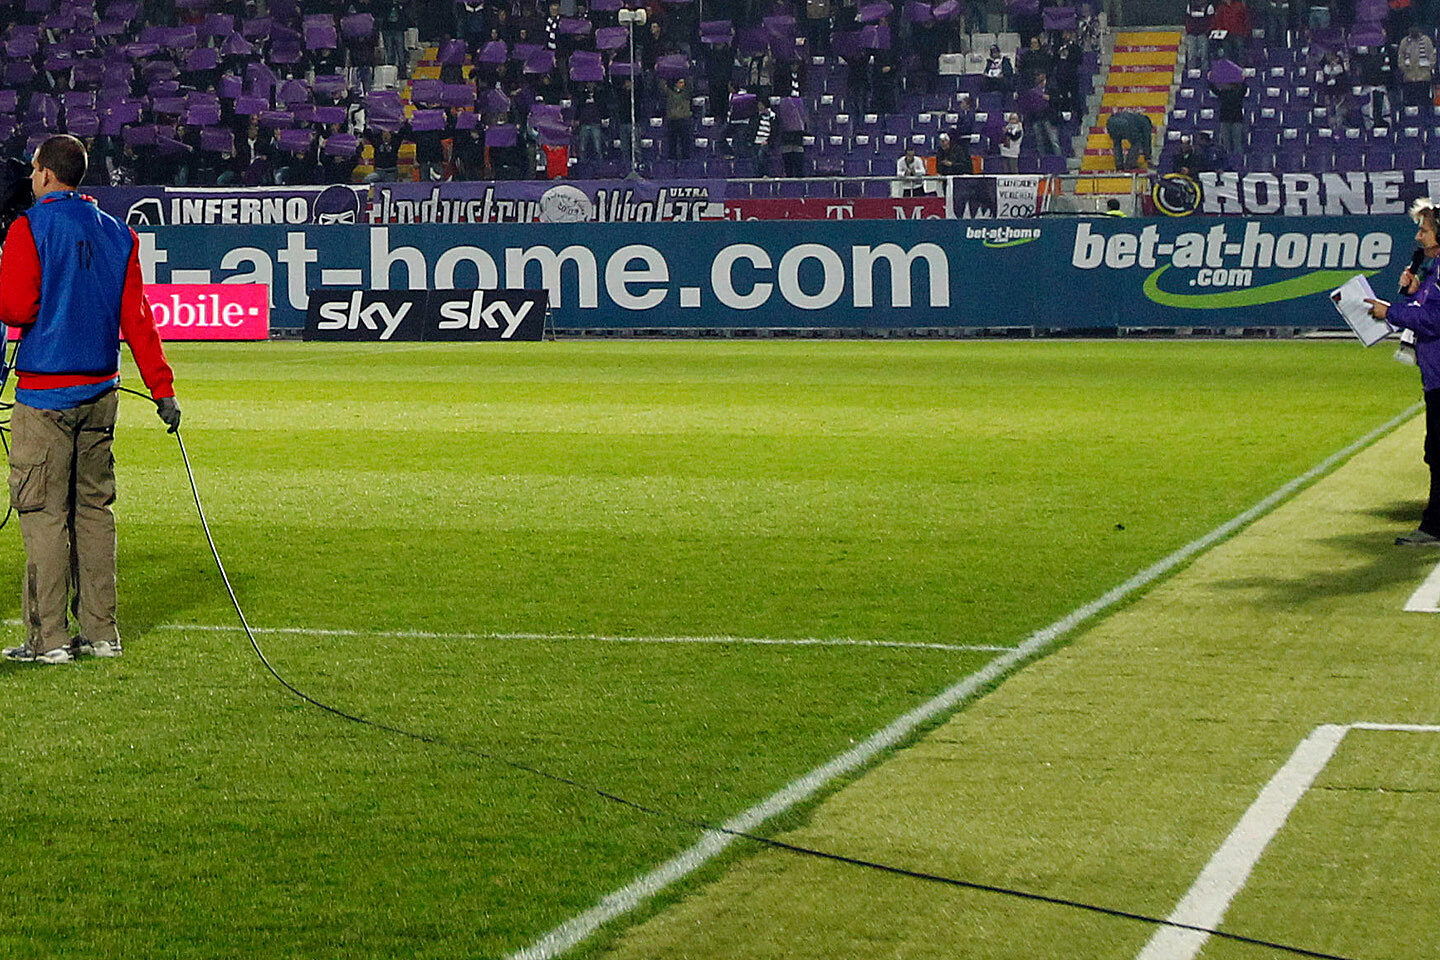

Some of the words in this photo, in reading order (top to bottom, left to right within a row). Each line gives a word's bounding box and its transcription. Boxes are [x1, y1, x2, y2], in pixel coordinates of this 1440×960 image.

[669, 187, 710, 198] ULTRA
[170, 196, 309, 225] INFERNO
[966, 225, 1042, 239] bet-at-home
[1071, 222, 1395, 270] bet-at-home
[1188, 268, 1253, 288] .com
[149, 293, 244, 328] obile
[318, 291, 414, 340] sky
[437, 290, 535, 340] sky
